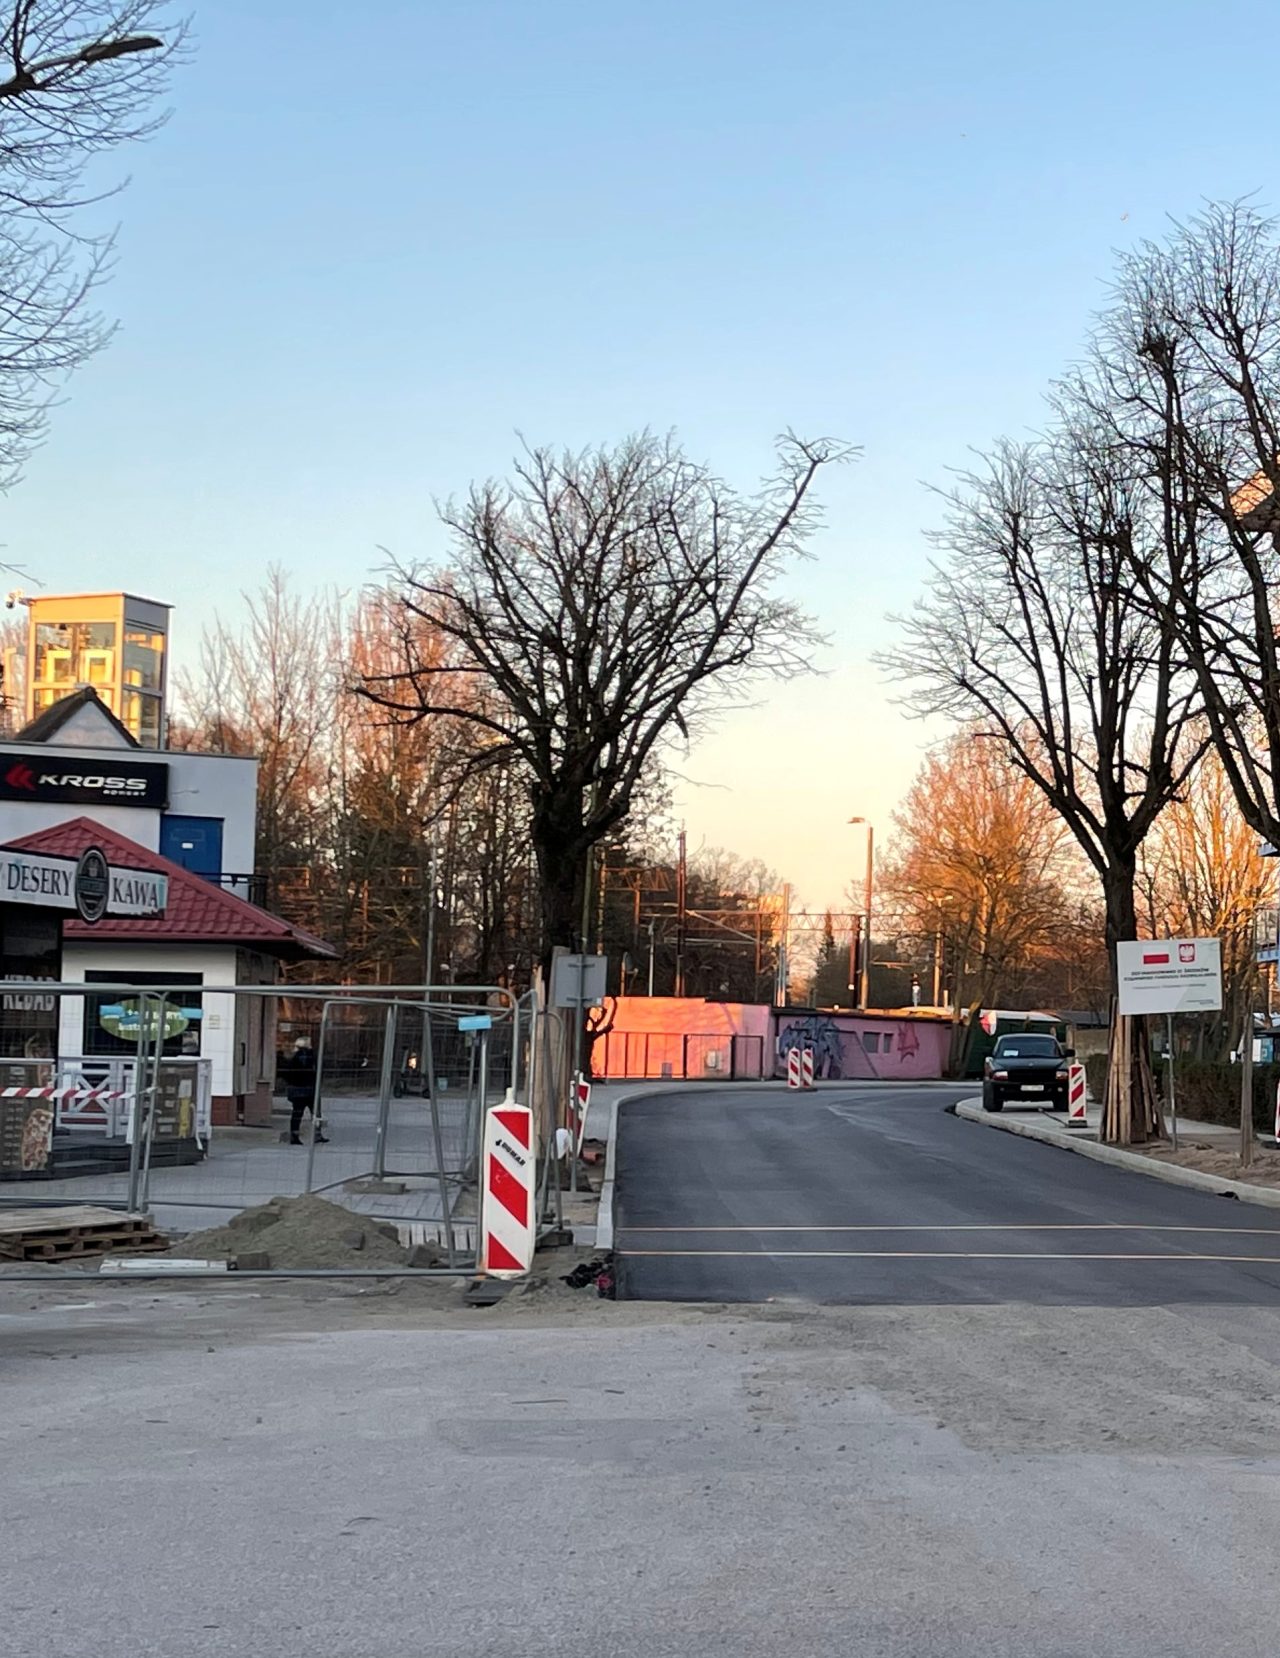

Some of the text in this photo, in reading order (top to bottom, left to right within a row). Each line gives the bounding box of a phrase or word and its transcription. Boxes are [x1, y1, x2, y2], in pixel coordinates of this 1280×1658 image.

[38, 774, 148, 790] KROSS
[7, 863, 74, 897] DESERY
[112, 876, 158, 909] KAWA
